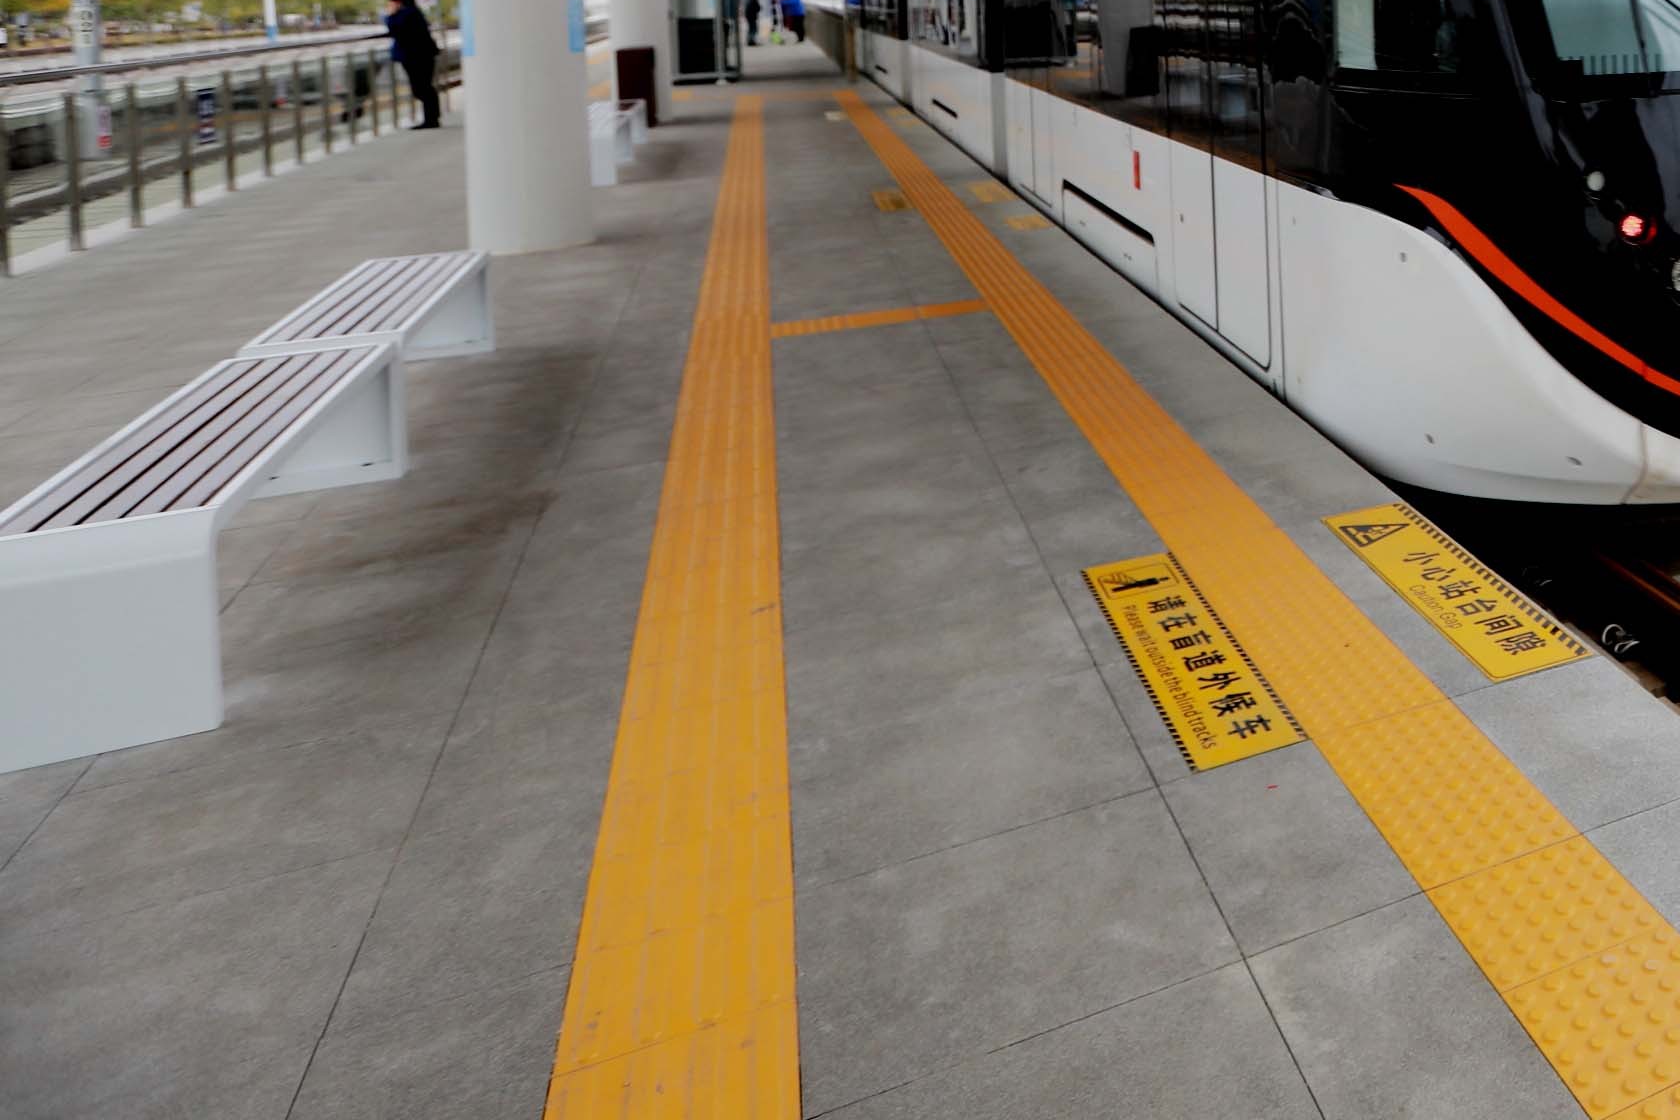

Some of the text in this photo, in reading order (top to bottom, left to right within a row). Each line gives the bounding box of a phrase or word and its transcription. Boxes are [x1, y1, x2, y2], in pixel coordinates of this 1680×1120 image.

[1402, 551, 1546, 655] 小心站台间隙
[1409, 584, 1463, 630] Caution Gap
[1122, 604, 1216, 750] Please wait outside the blind tracks
[1147, 595, 1272, 739] 请在盲道外候车
